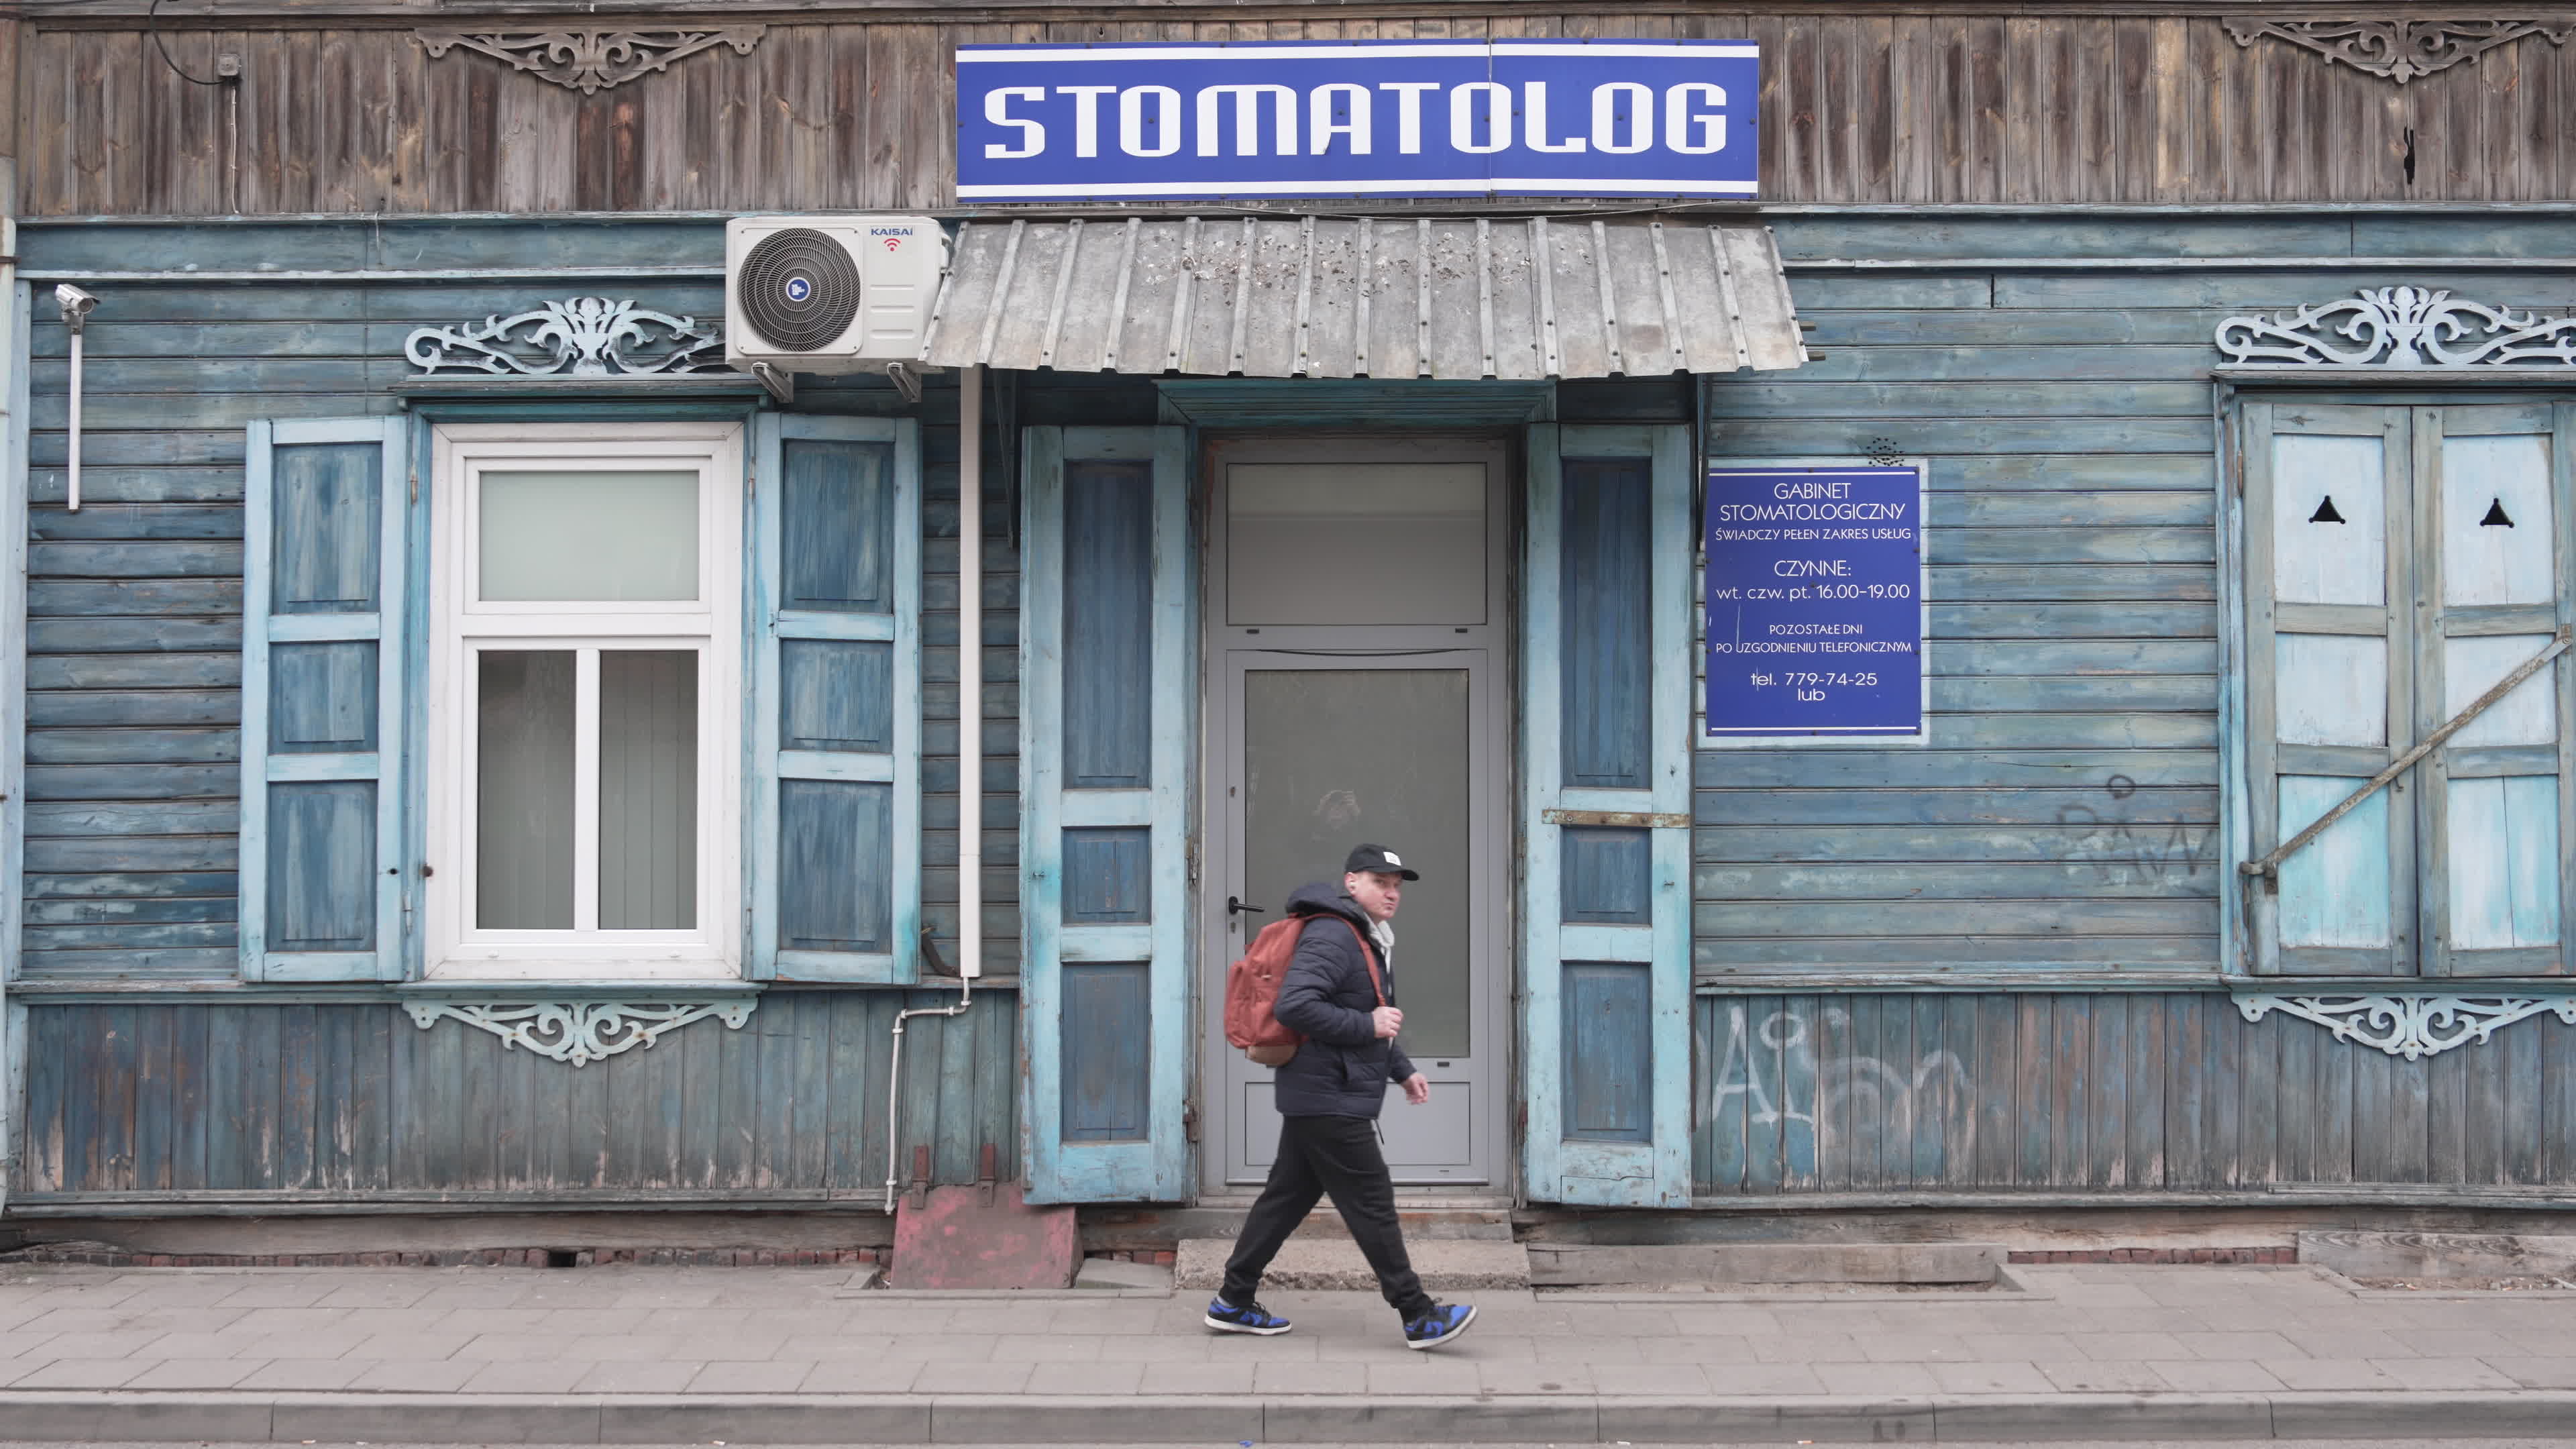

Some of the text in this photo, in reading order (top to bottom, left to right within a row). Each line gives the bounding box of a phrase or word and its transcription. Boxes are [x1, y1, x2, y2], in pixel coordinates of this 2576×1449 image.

[984, 81, 1727, 159] STOMATOLOG
[871, 227, 913, 235] KAISAI
[1774, 482, 1851, 500] GABINET
[1720, 503, 1906, 521] STOMATOLOGICZNY
[1715, 527, 1911, 541] ŚWIADCZY PEŁEN ZAKRES USŁUG
[1774, 559, 1851, 577] CZYNNE:
[1716, 584, 1911, 602] wt. czw. pt. 16.00-19.00
[1769, 624, 1863, 635] POZOSTAŁE DNI
[1716, 641, 1912, 653] PO UZGODNIENIU TELEFONICZNYM
[1751, 672, 1878, 686] tel. 779-74-25
[1798, 688, 1825, 702] lub
